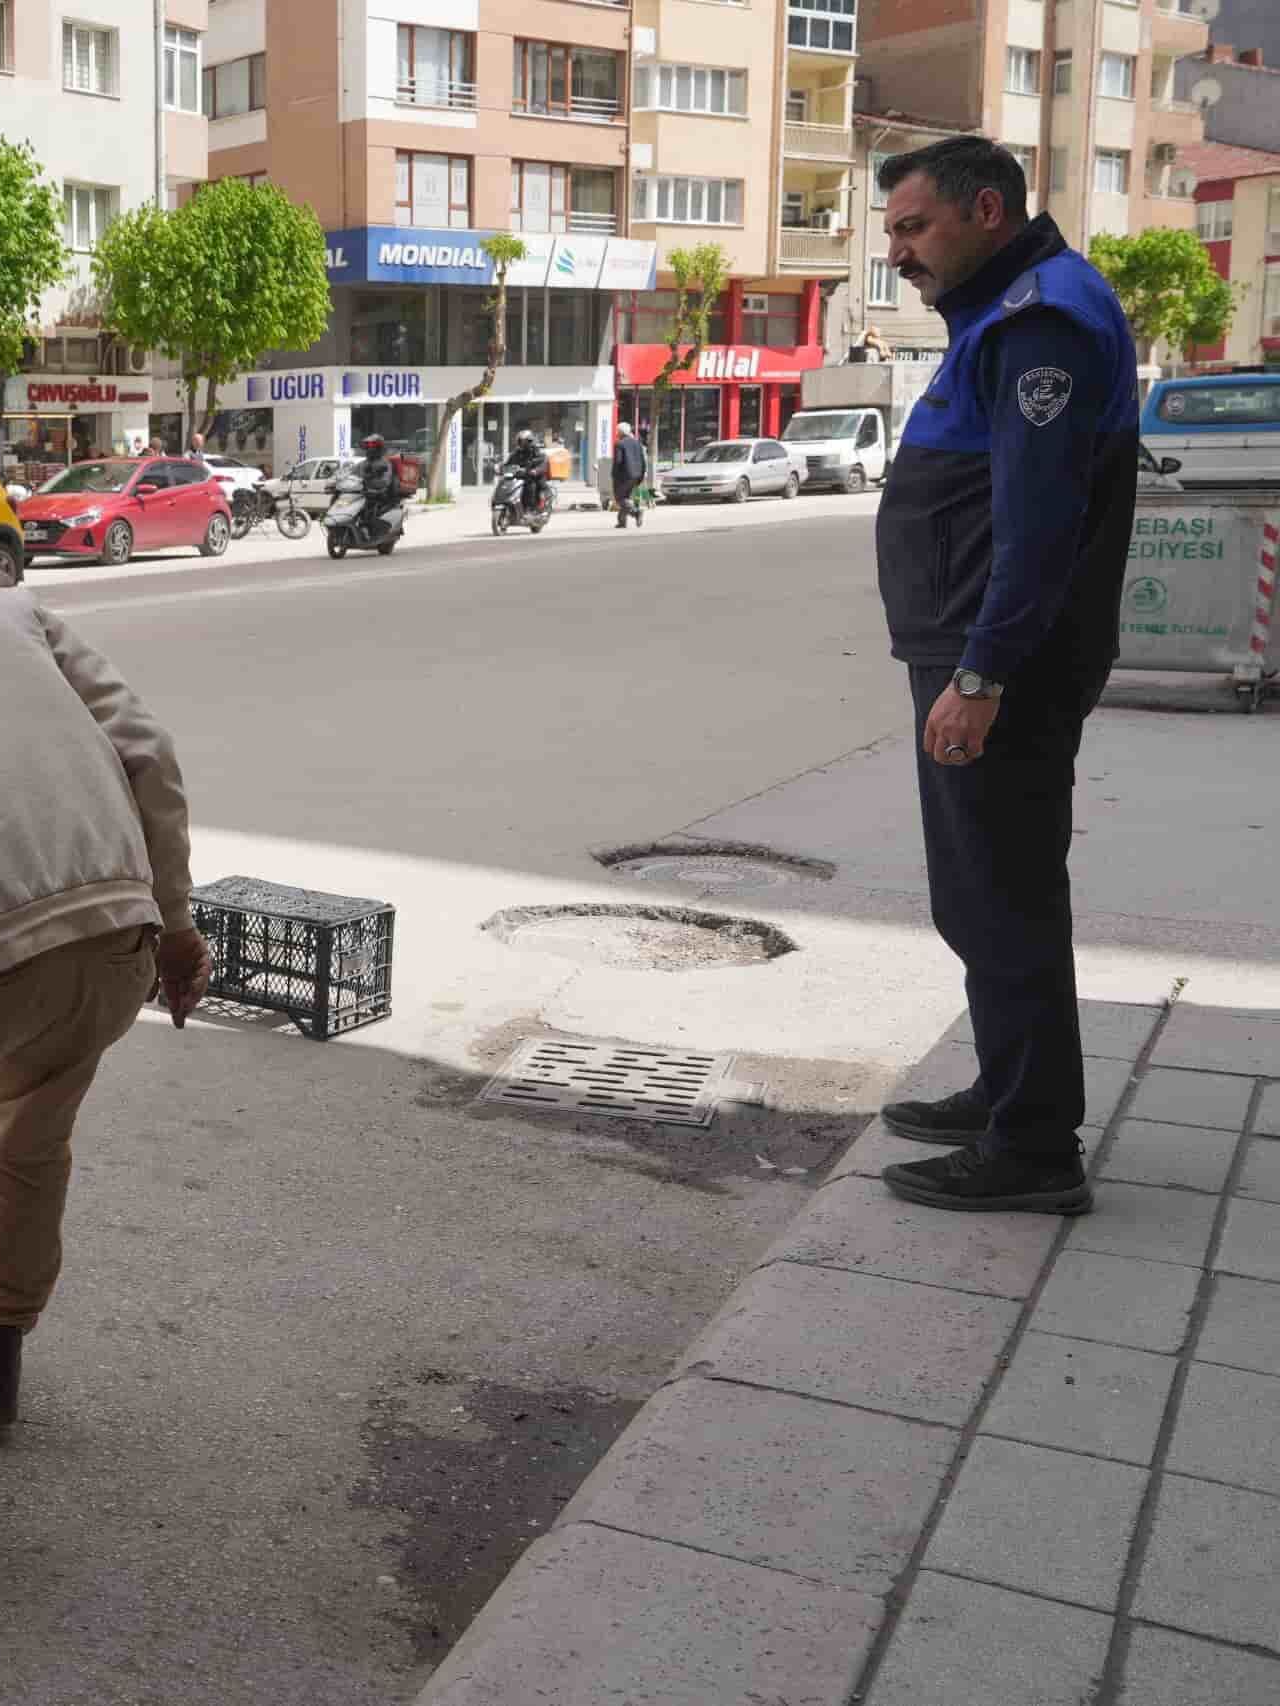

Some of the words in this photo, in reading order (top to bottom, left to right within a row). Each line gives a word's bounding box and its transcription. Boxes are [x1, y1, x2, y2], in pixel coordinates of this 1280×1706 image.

[378, 242, 487, 269] MONDIAL
[697, 348, 761, 378] Hilal
[1135, 518, 1215, 538] EBAŞI
[1128, 539, 1224, 560] EDİYESİ
